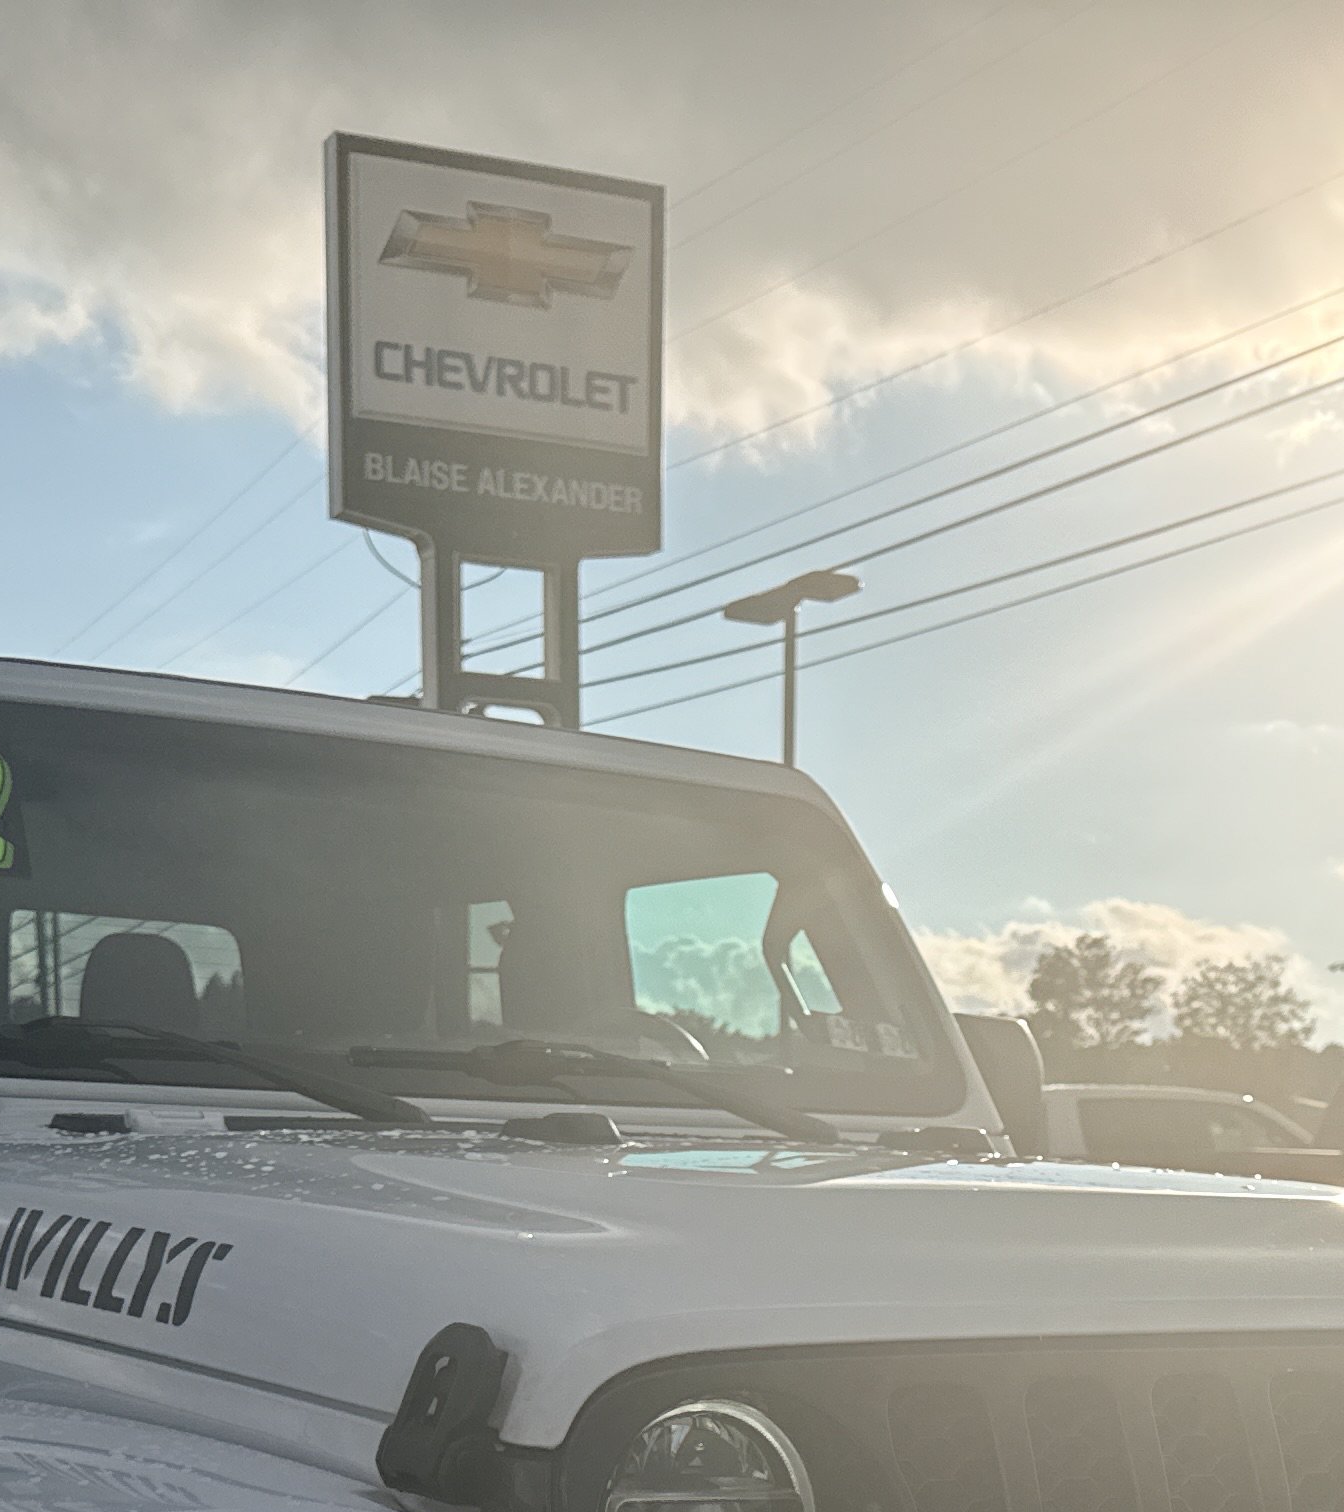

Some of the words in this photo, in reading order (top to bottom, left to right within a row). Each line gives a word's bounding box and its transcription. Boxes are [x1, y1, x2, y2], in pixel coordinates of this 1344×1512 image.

[374, 341, 638, 414] CHEVROLET
[364, 452, 468, 493] BLAISE
[477, 467, 643, 514] ALEXANDER
